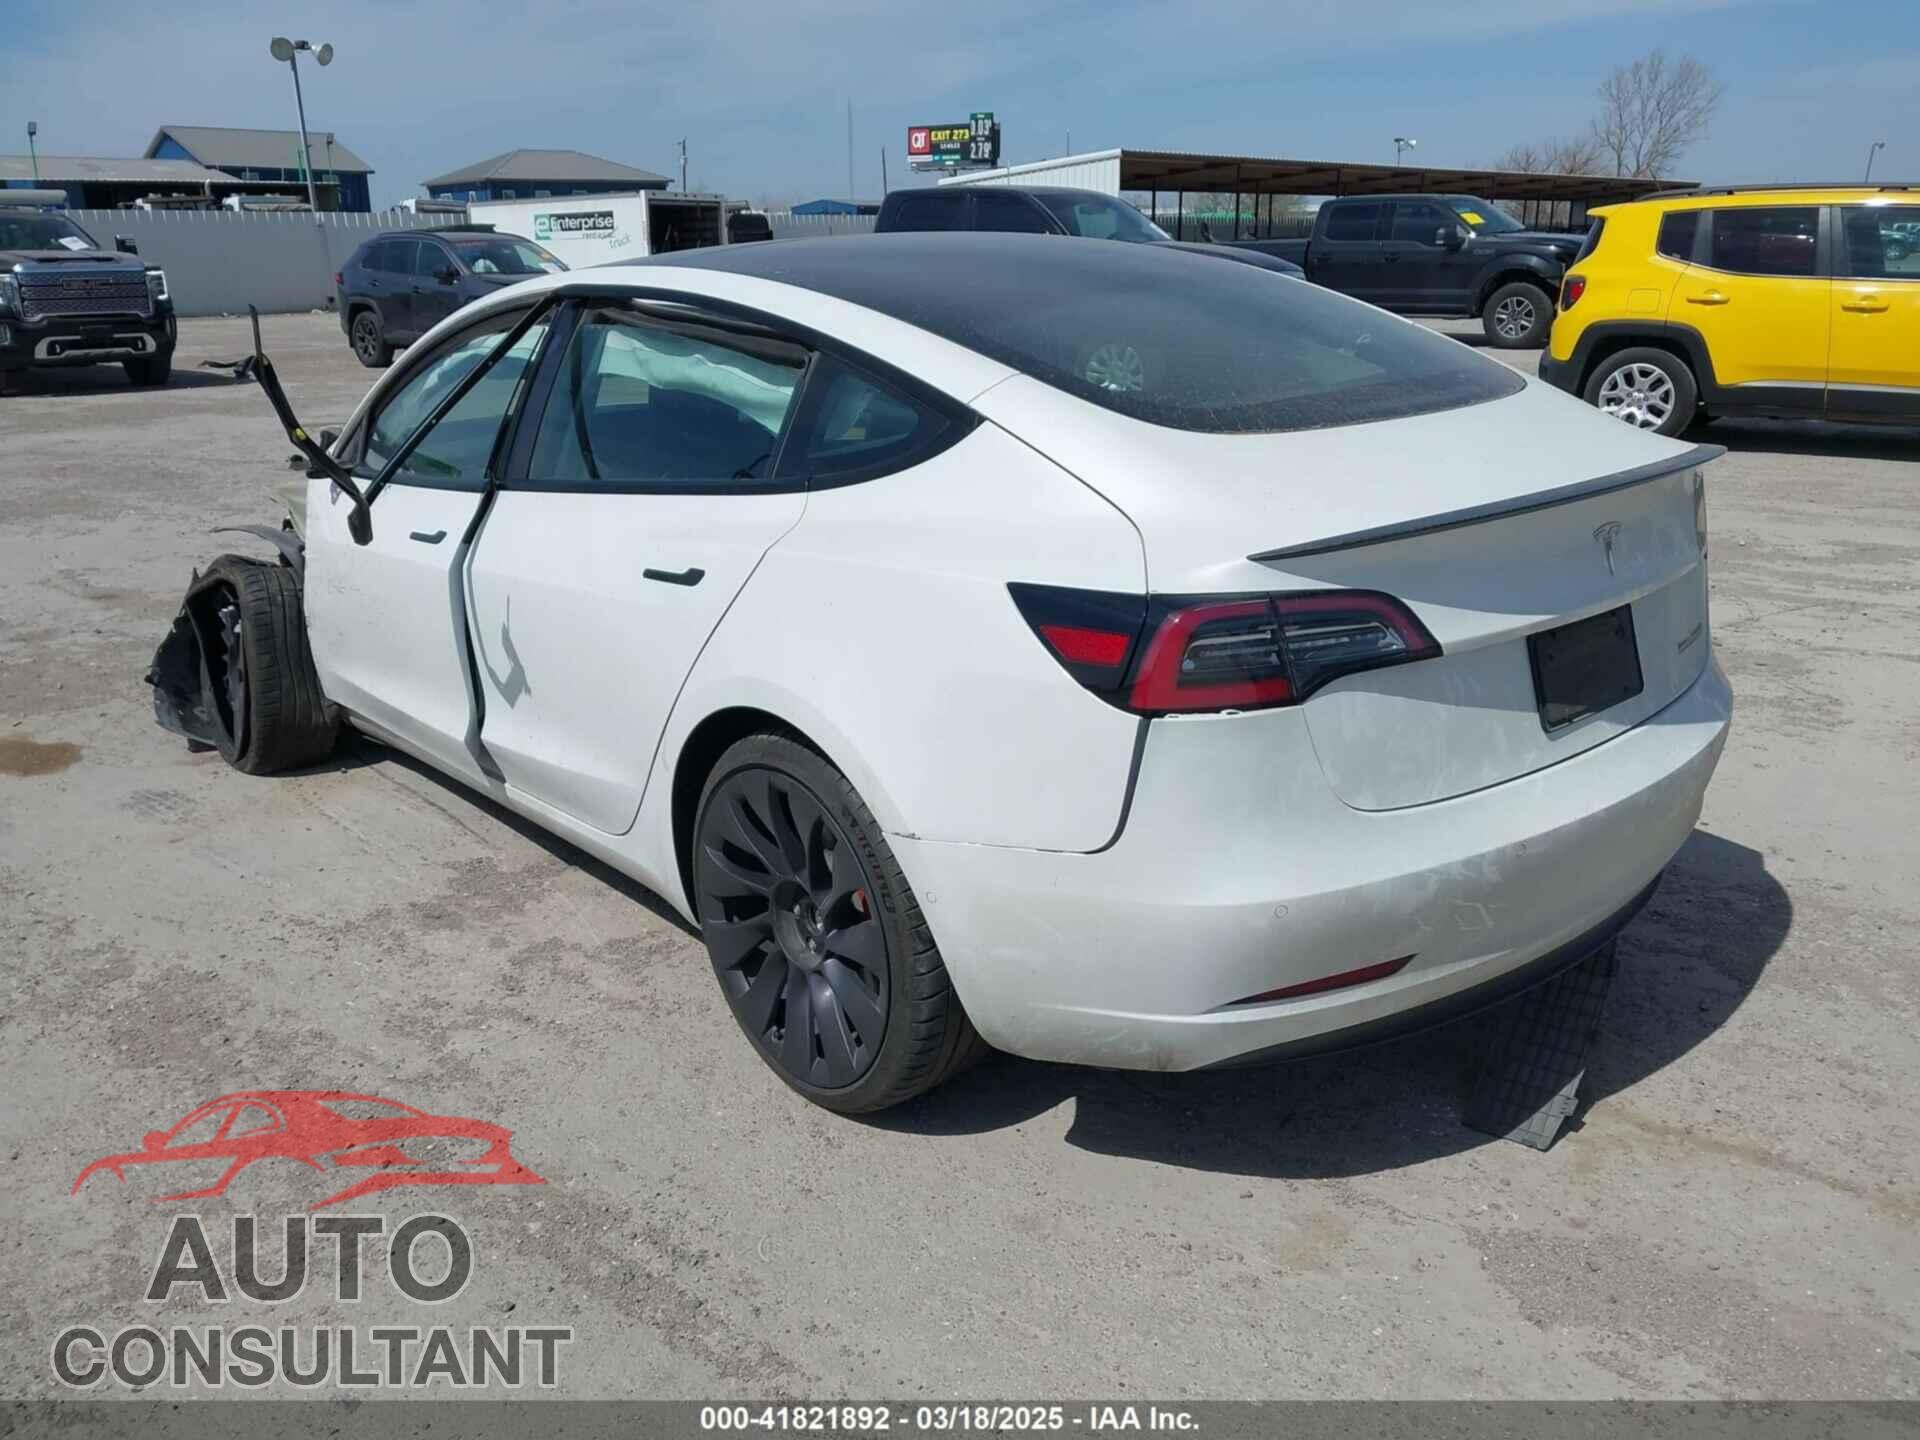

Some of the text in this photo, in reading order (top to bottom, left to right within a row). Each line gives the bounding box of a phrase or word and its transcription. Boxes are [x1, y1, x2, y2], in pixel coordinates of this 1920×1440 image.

[911, 132, 927, 149] QT
[931, 130, 951, 141] EXIT
[952, 128, 970, 140] 273
[550, 213, 613, 231] Enterprise
